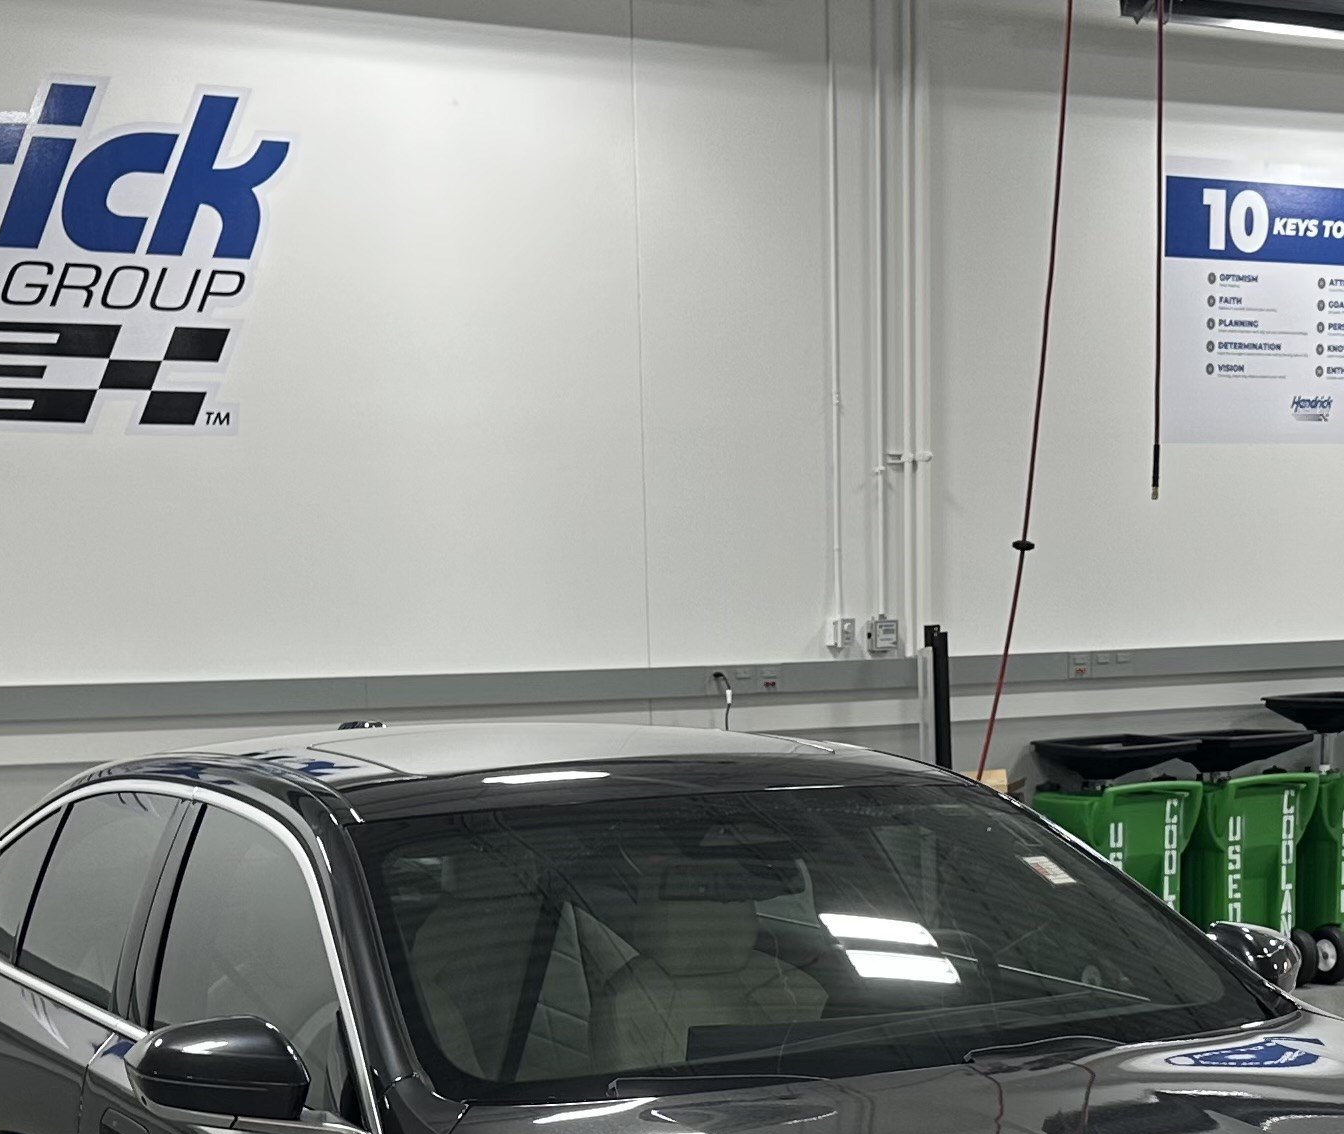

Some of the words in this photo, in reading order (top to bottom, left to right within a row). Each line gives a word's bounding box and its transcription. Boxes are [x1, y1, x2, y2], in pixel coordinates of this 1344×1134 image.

[1202, 187, 1269, 254] 10
[1272, 217, 1319, 237] KEYS
[1219, 273, 1259, 283] OPTIMISM
[0, 260, 247, 313] GROUP
[1218, 296, 1243, 305] FAITH
[1218, 319, 1259, 328] PLANNING
[1217, 341, 1282, 351] DETERMINATION
[1217, 364, 1245, 373] VISION
[206, 411, 230, 426] TM
[1280, 789, 1296, 939] COOLAN
